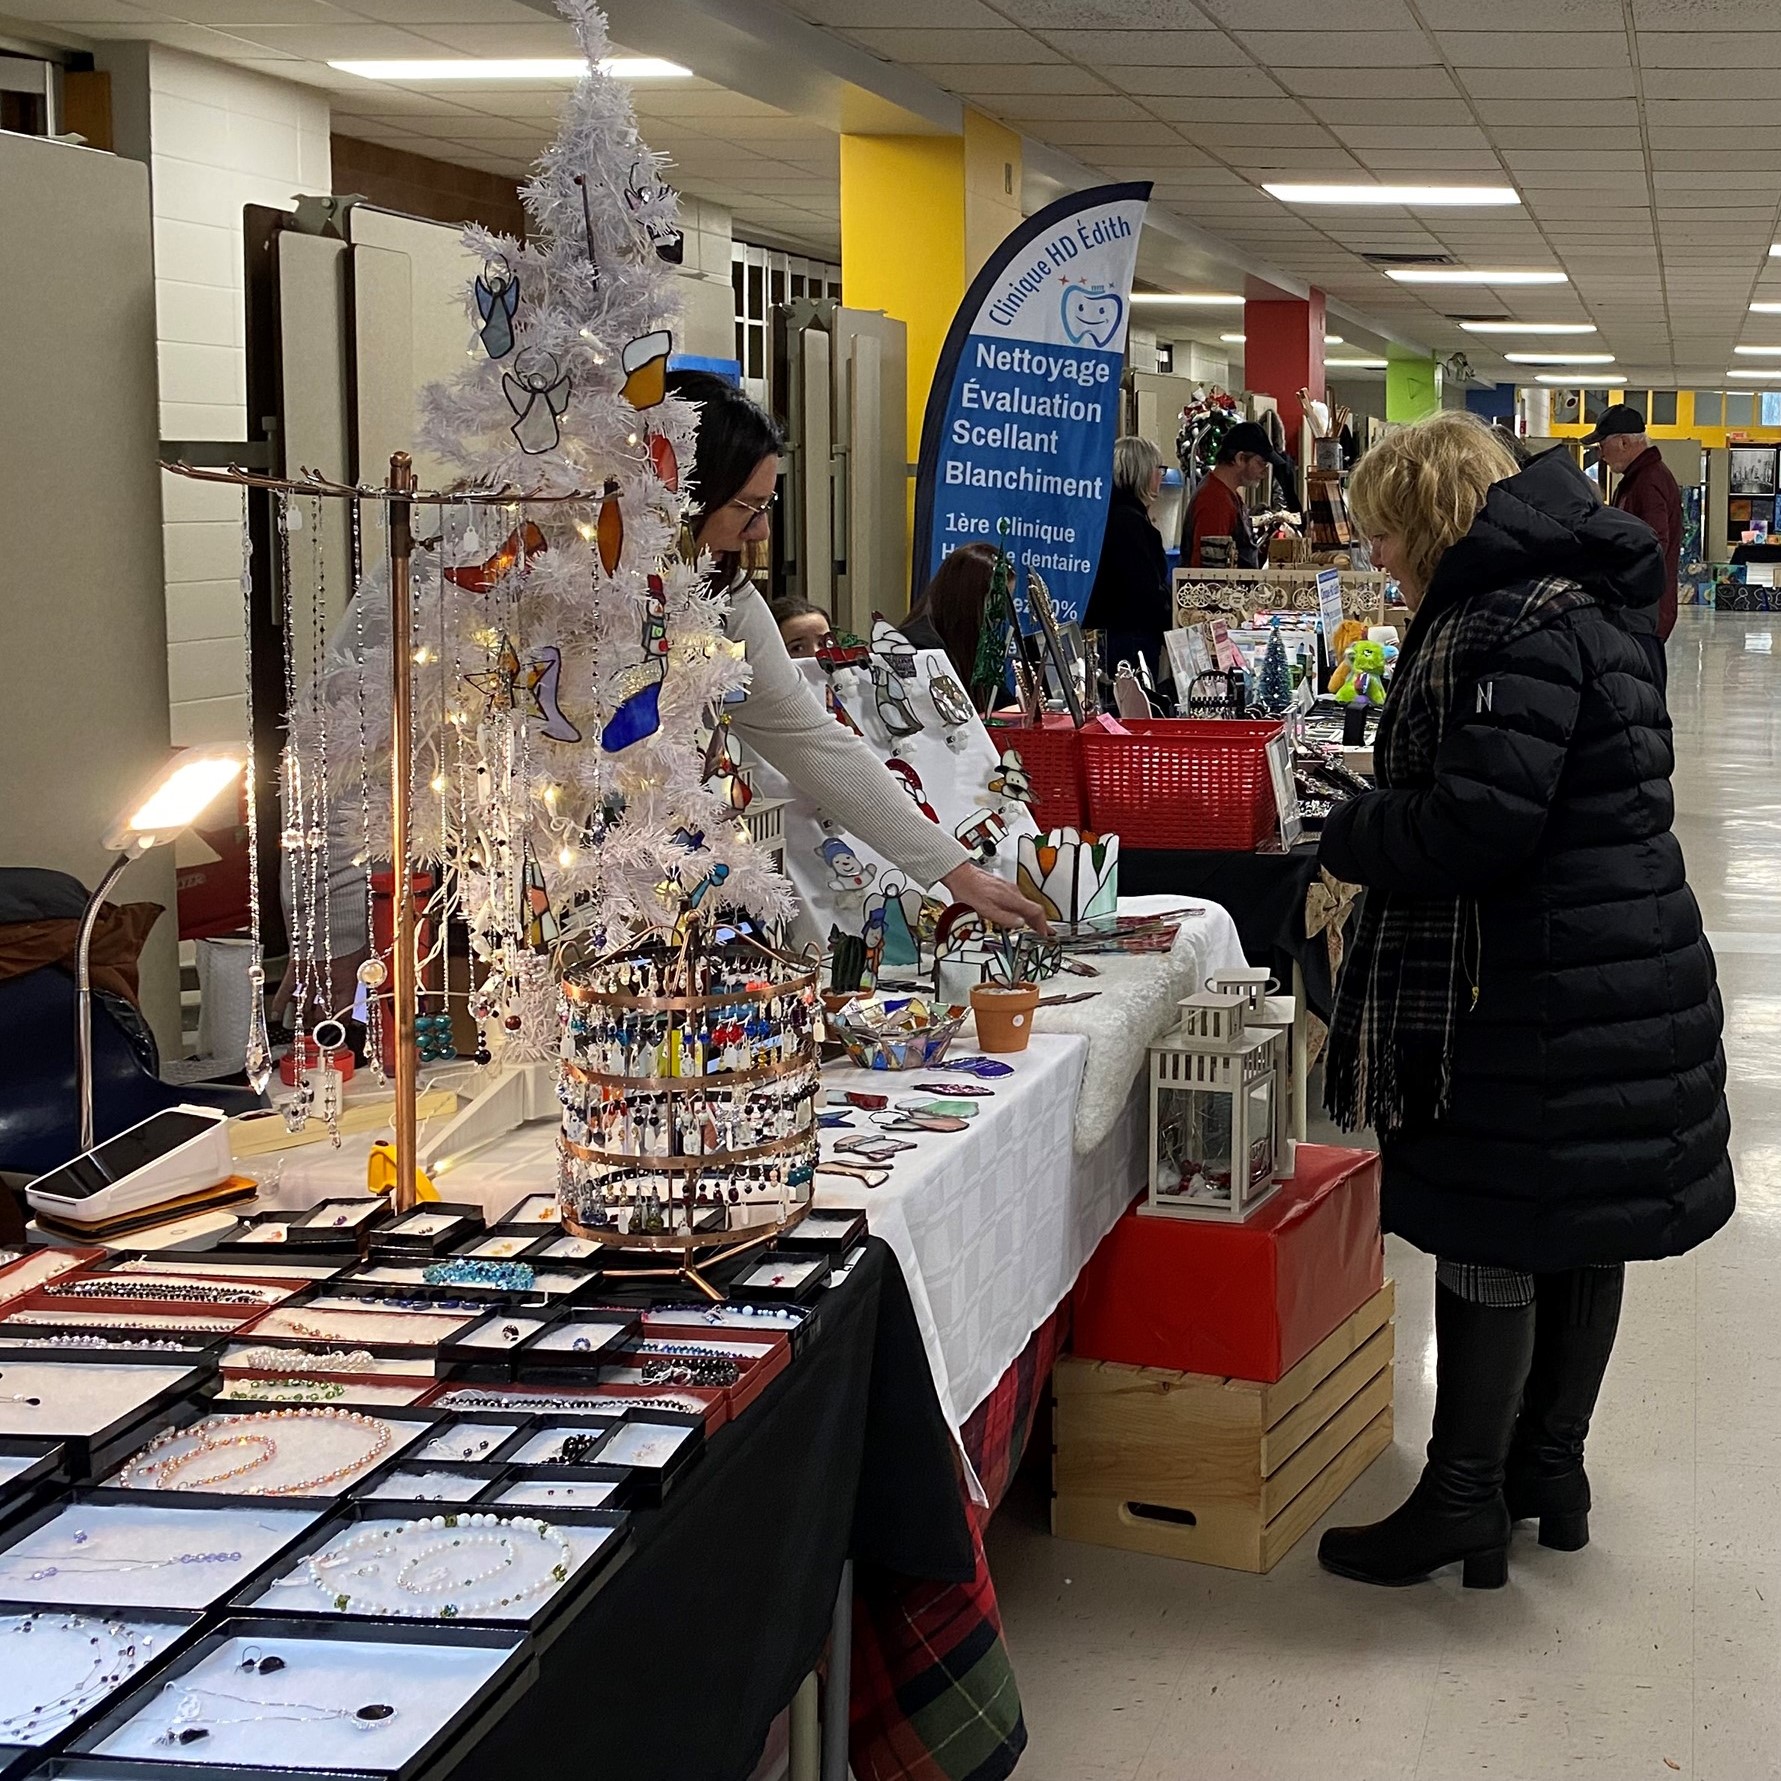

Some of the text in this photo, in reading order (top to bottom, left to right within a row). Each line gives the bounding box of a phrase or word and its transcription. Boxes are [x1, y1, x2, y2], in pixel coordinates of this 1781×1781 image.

[989, 216, 1132, 326] Clinique HD Édith
[976, 343, 1110, 387] Nettoyage
[961, 378, 1102, 423] Évaluation
[952, 419, 1059, 454] Scellant
[945, 460, 1103, 500] Blanchiment
[945, 512, 1076, 544] 1ère Clinique
[1021, 548, 1091, 574] dentaire
[1049, 599, 1078, 620] 0%
[1476, 681, 1493, 714] N
